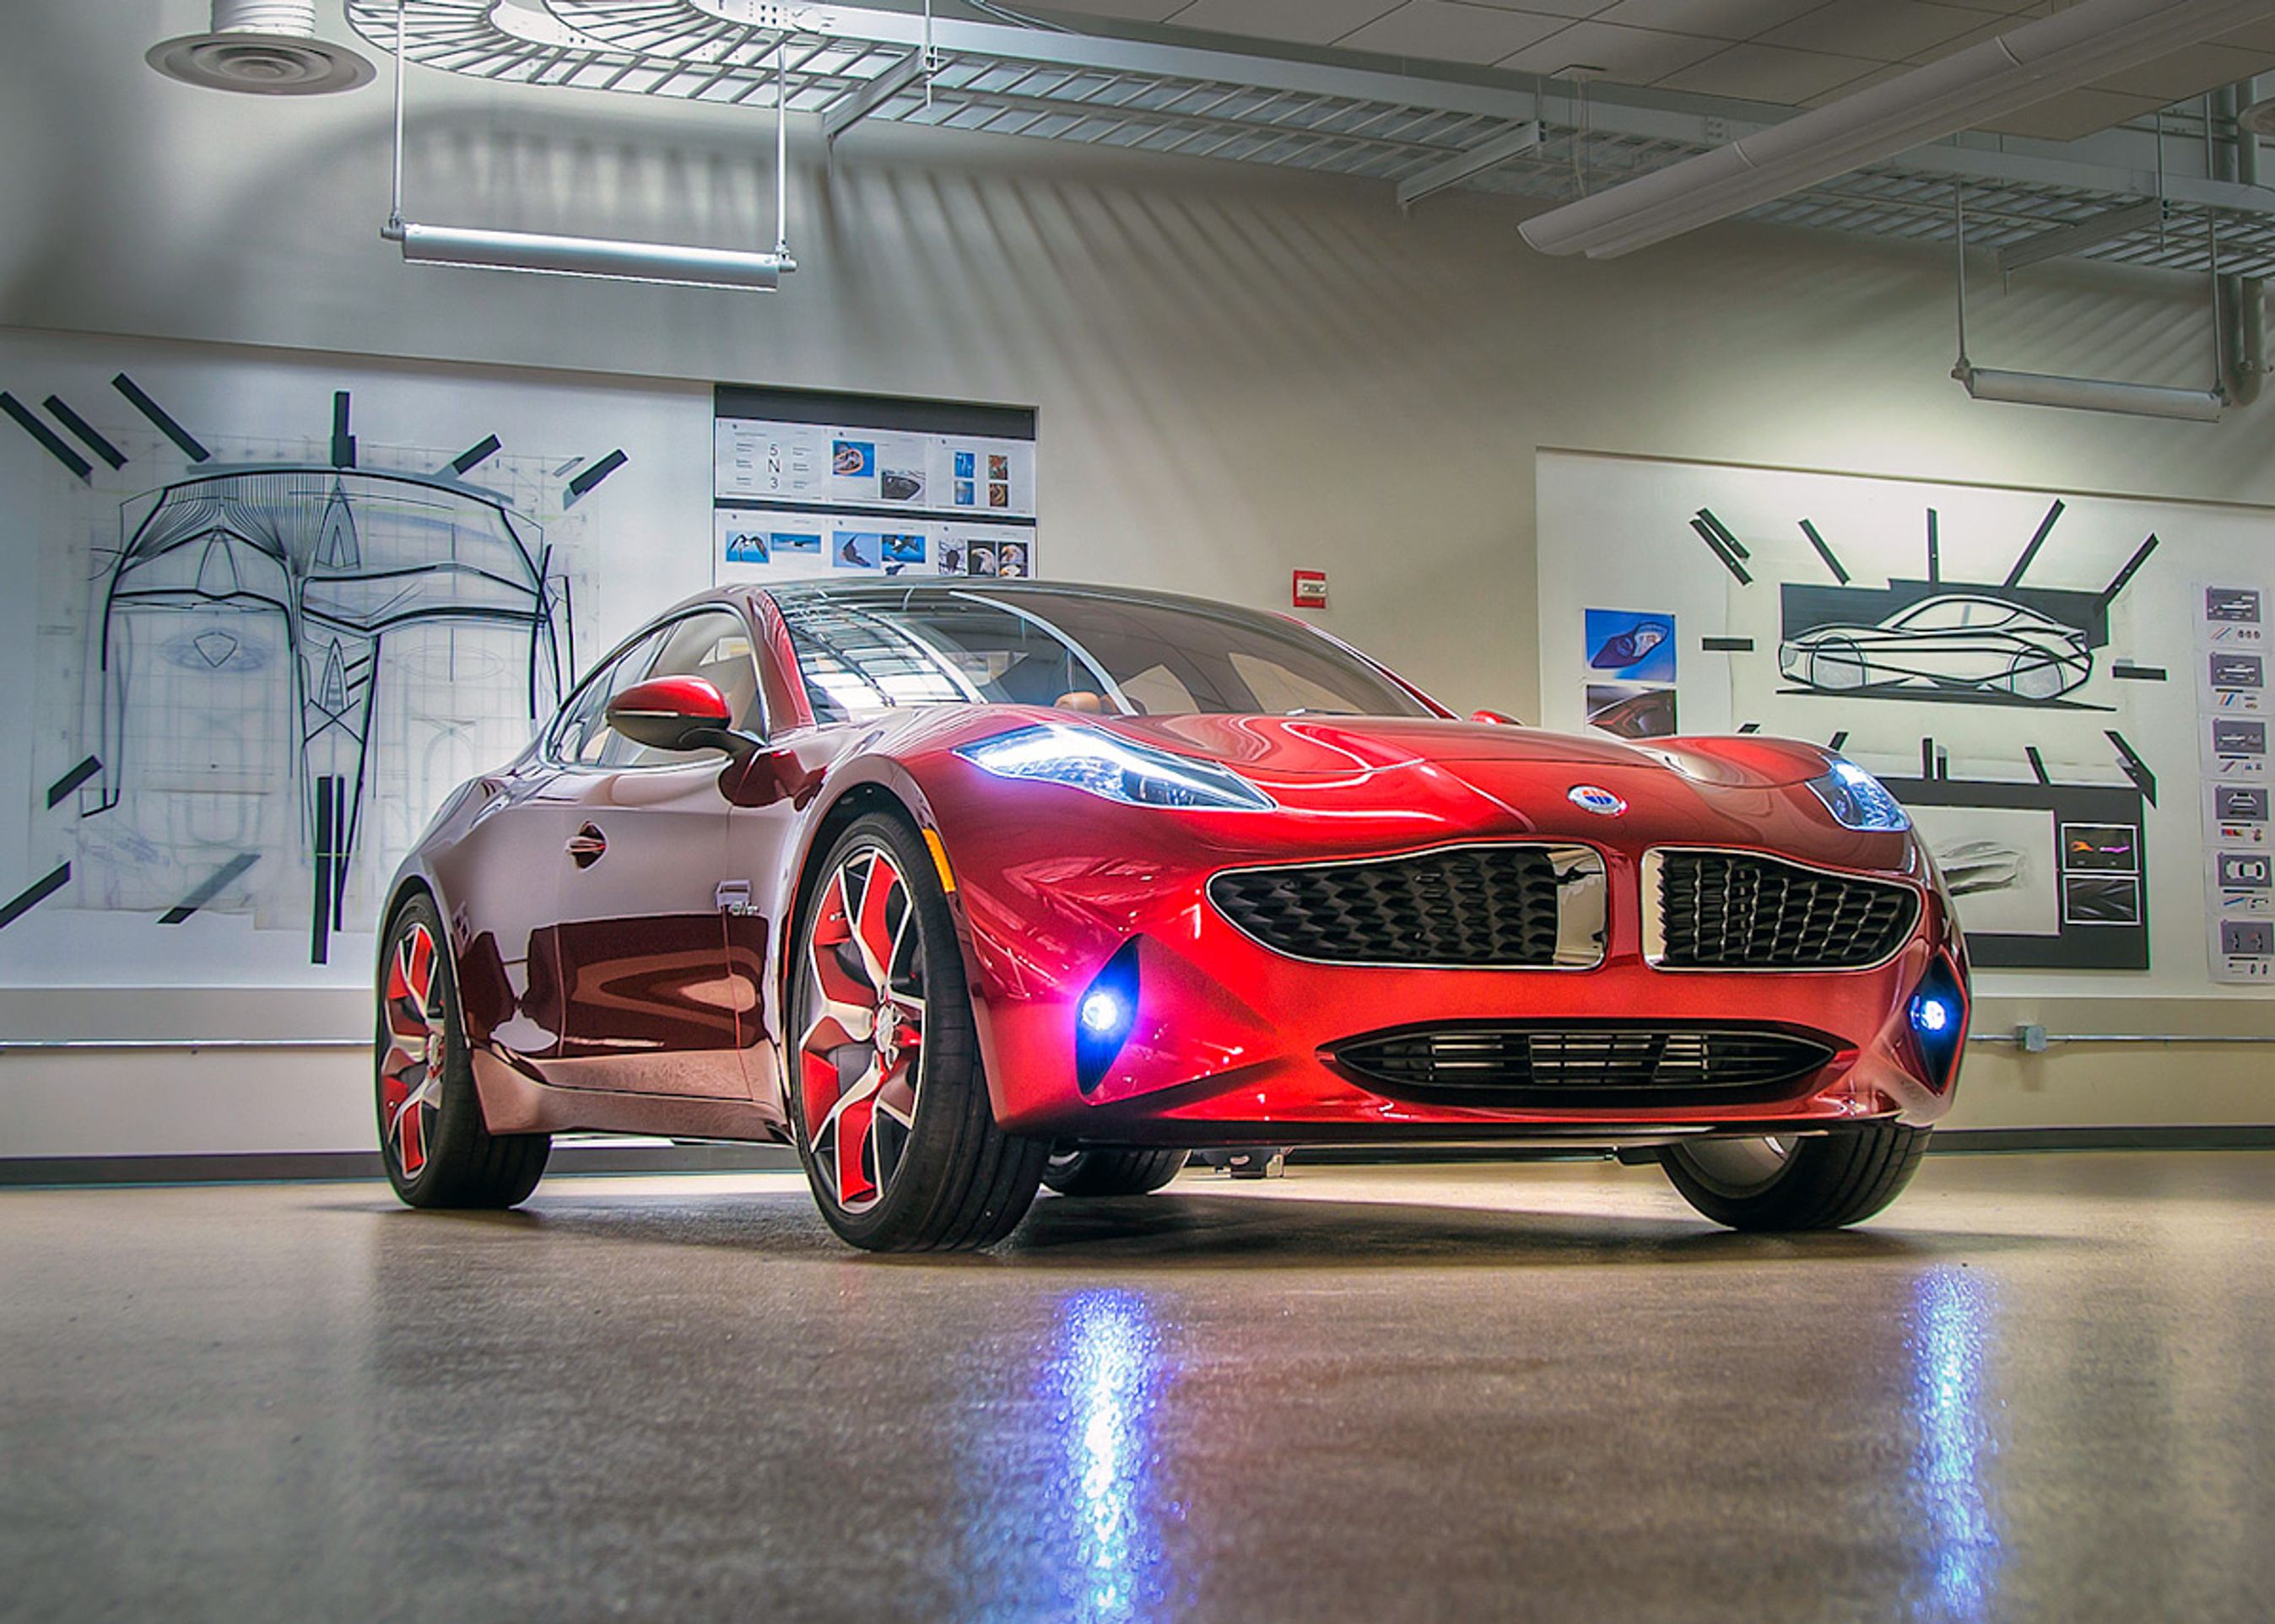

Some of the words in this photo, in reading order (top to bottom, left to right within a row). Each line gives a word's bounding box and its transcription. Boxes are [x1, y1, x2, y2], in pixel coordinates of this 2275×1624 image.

[770, 443, 778, 456] 5
[768, 459, 780, 472] N
[770, 477, 778, 489] 3
